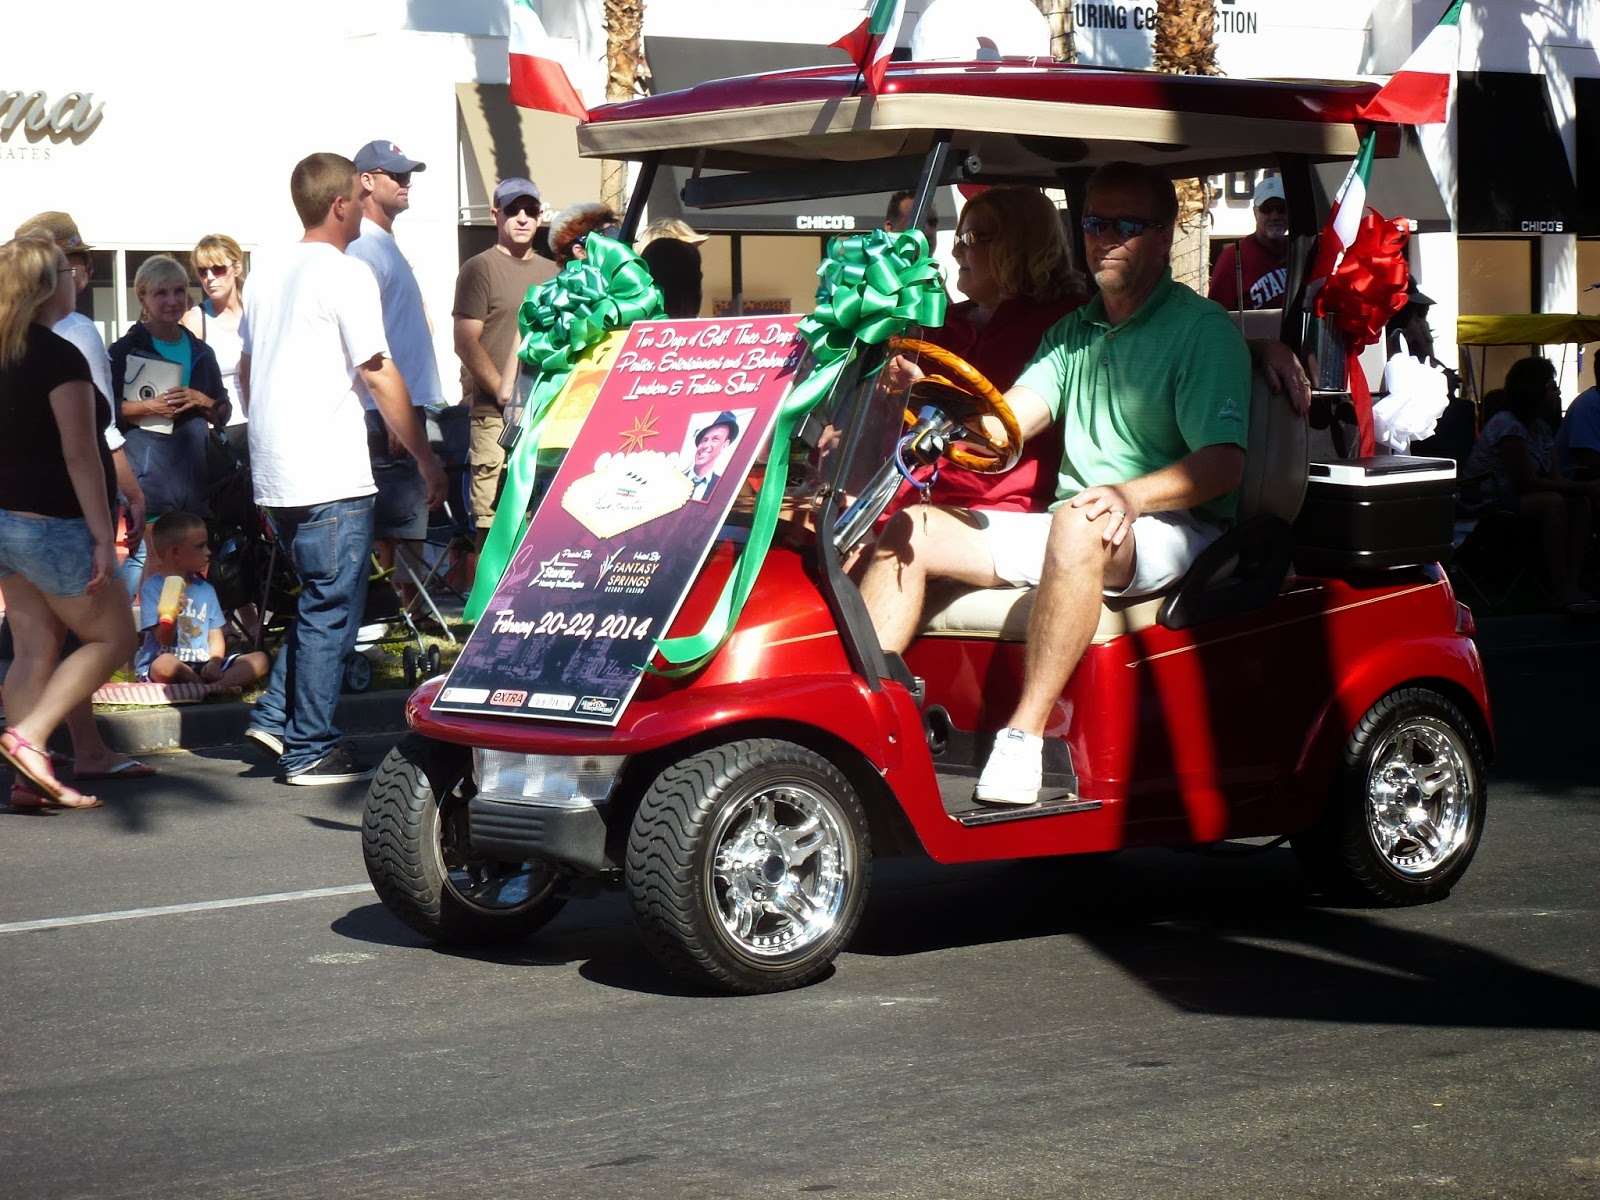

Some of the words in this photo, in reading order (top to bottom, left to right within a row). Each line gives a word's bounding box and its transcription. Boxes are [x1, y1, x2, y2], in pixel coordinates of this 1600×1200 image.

[1075, 3, 1127, 30] URING
[0, 90, 106, 134] ma
[0, 147, 51, 160] ATES
[796, 215, 856, 230] CHICO'S
[1521, 220, 1564, 232] CHICO'S
[635, 326, 656, 349] Two
[655, 327, 688, 352] Days
[699, 324, 734, 349] Golf!
[734, 323, 761, 345] Three
[760, 323, 796, 348] Days
[657, 351, 726, 373] Entertainment
[721, 353, 745, 370] and
[622, 375, 670, 400] Luncheon
[668, 380, 685, 396] &
[686, 373, 724, 396] Fashion
[724, 371, 766, 396] Show!
[612, 562, 660, 575] FANTASY
[607, 575, 652, 588] SPRINGS
[534, 611, 595, 641] 20-22,
[595, 614, 654, 641] 2014
